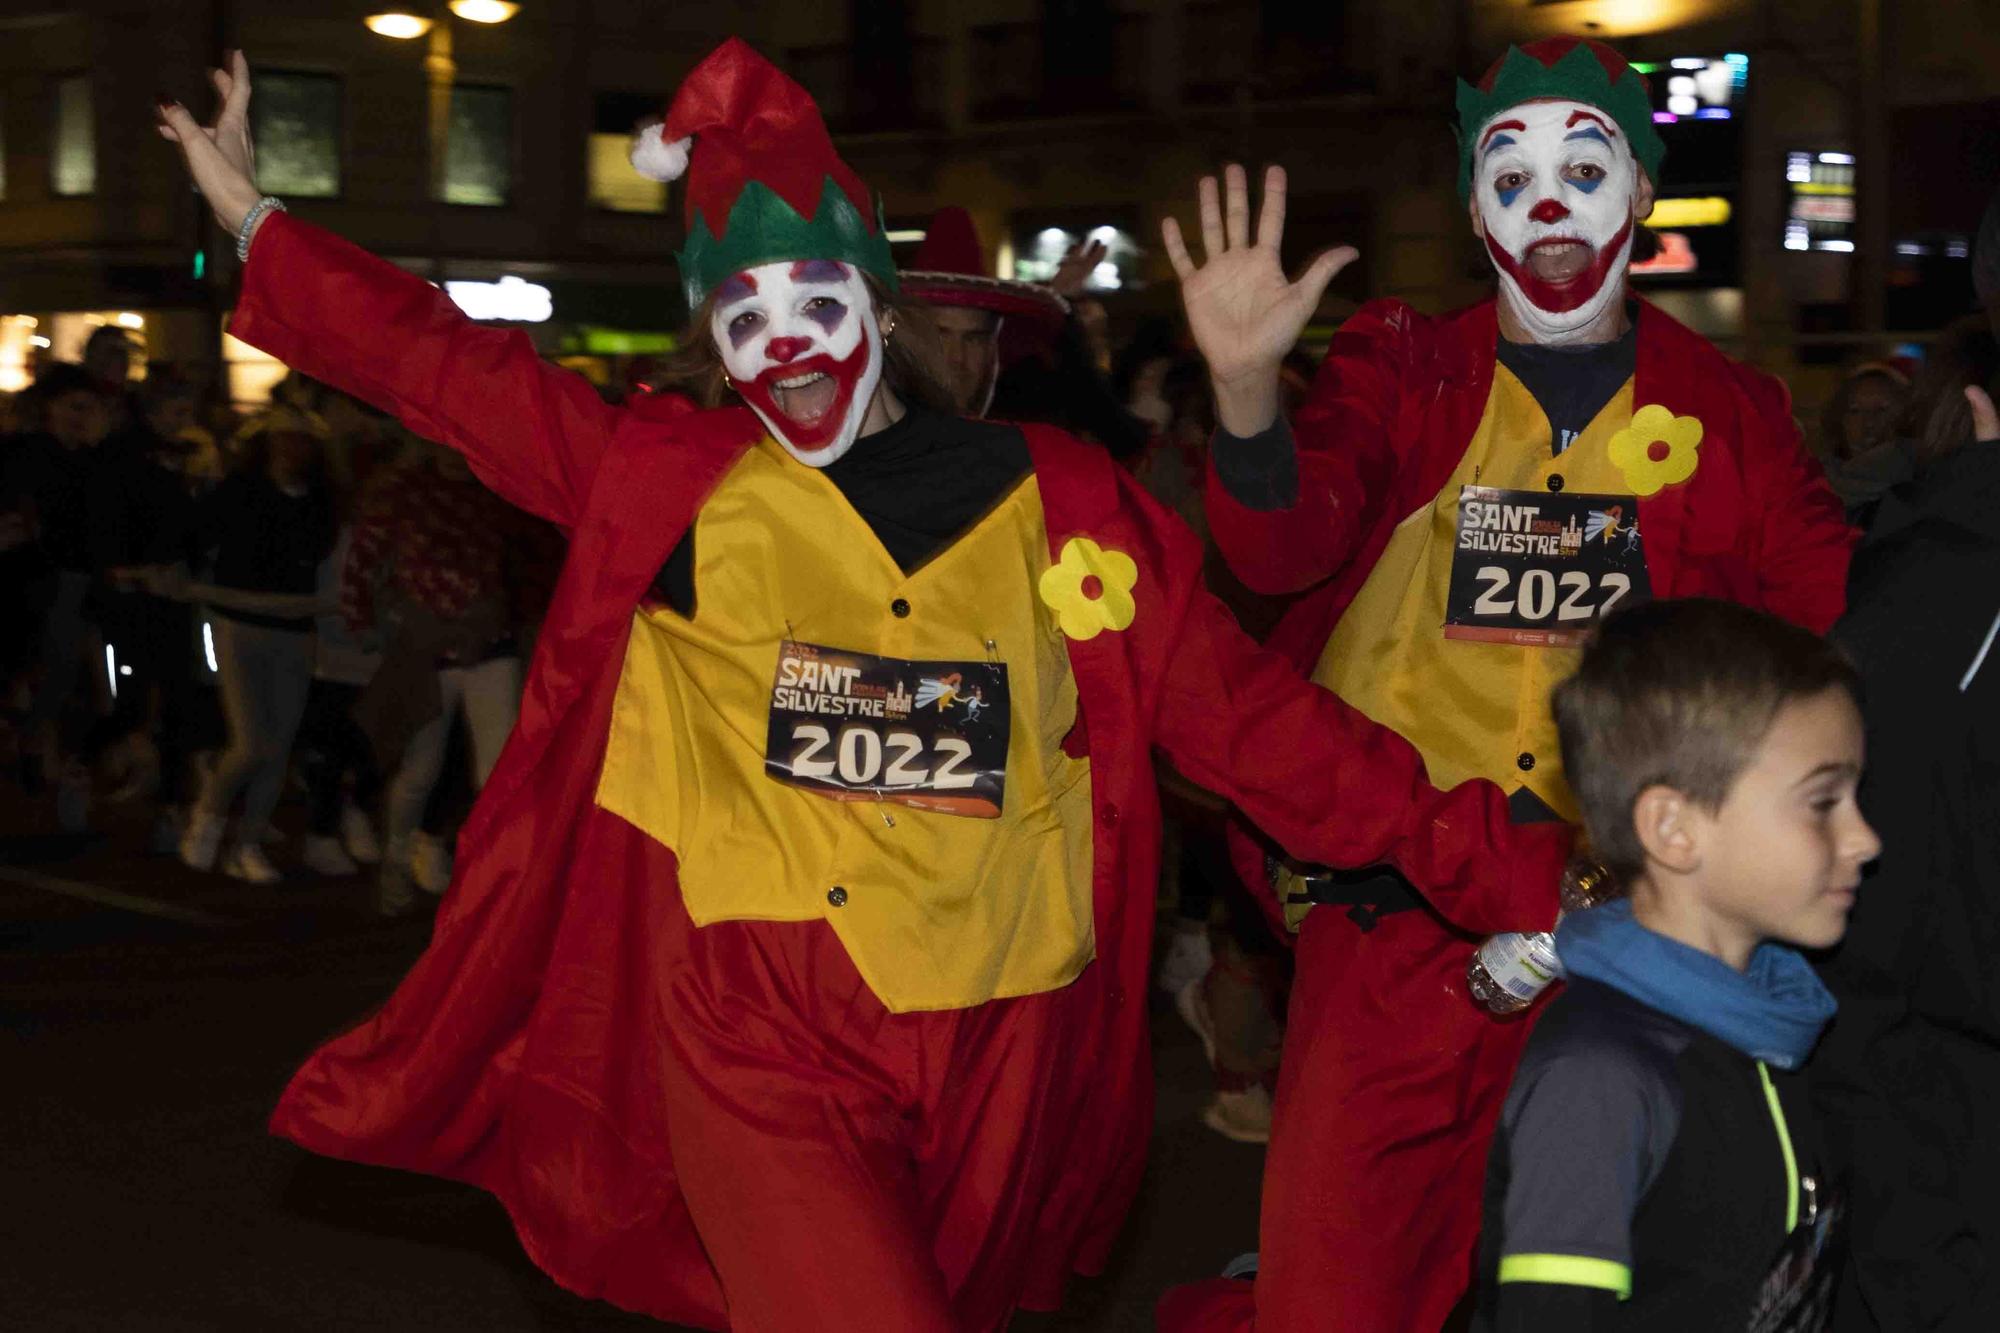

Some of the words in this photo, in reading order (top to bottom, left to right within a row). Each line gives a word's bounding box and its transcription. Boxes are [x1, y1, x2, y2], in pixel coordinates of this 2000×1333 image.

[1464, 502, 1540, 532] SANT
[1474, 566, 1631, 621] 2022
[779, 657, 861, 696] SANT
[792, 725, 977, 789] 2022
